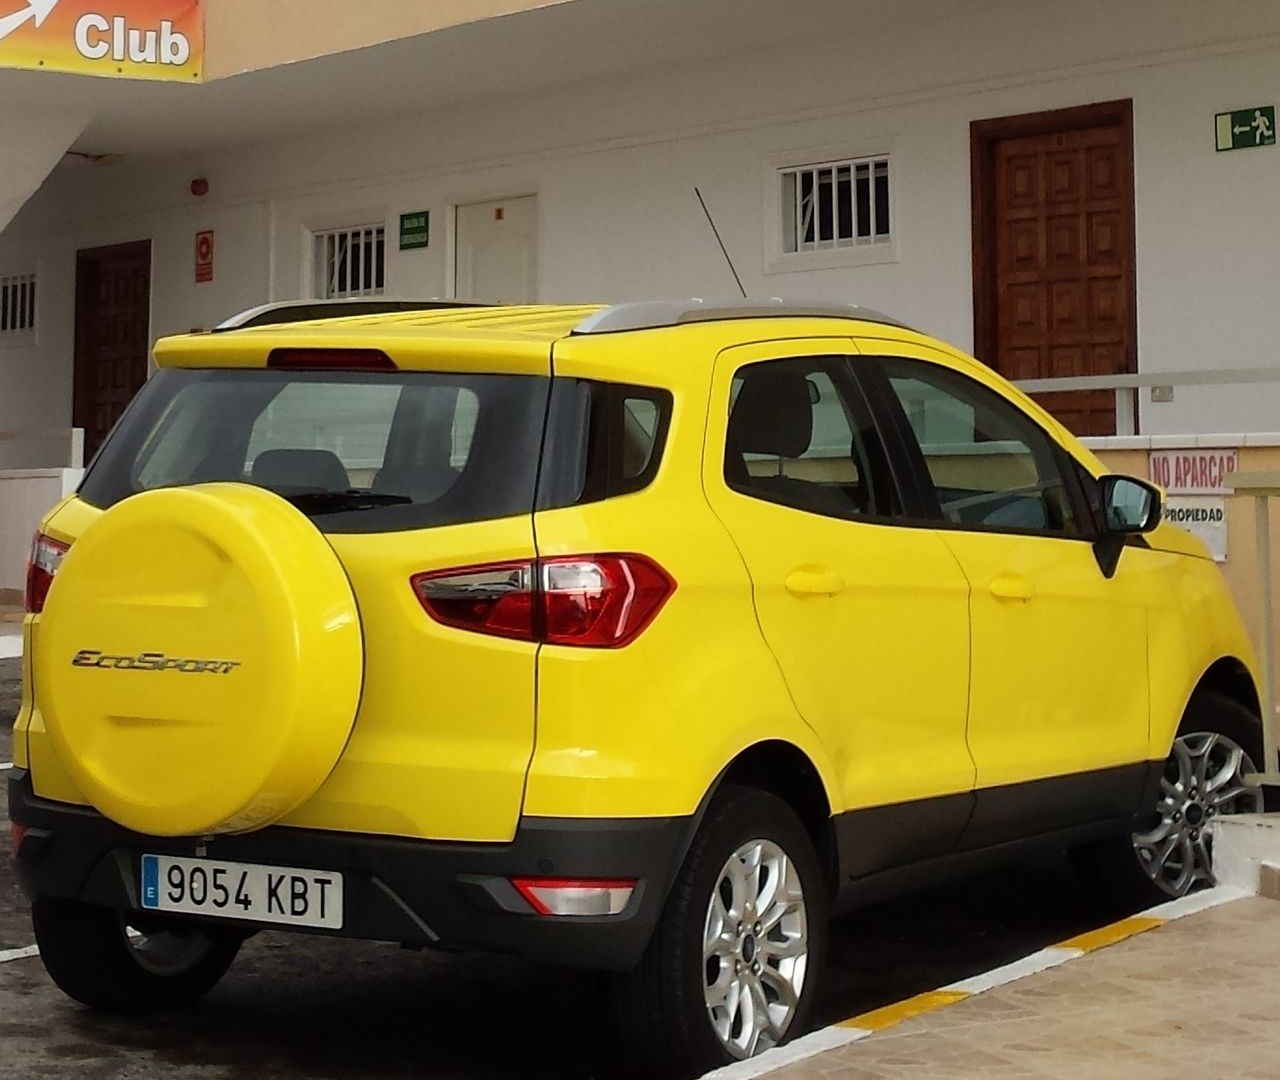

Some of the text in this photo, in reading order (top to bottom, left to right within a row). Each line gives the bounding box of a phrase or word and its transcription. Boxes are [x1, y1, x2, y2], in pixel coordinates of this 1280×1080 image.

[74, 12, 191, 66] Club
[1152, 455, 1170, 488] NO
[1165, 507, 1223, 522] PROPIEDAD
[146, 864, 332, 919] E 9054 KBT
